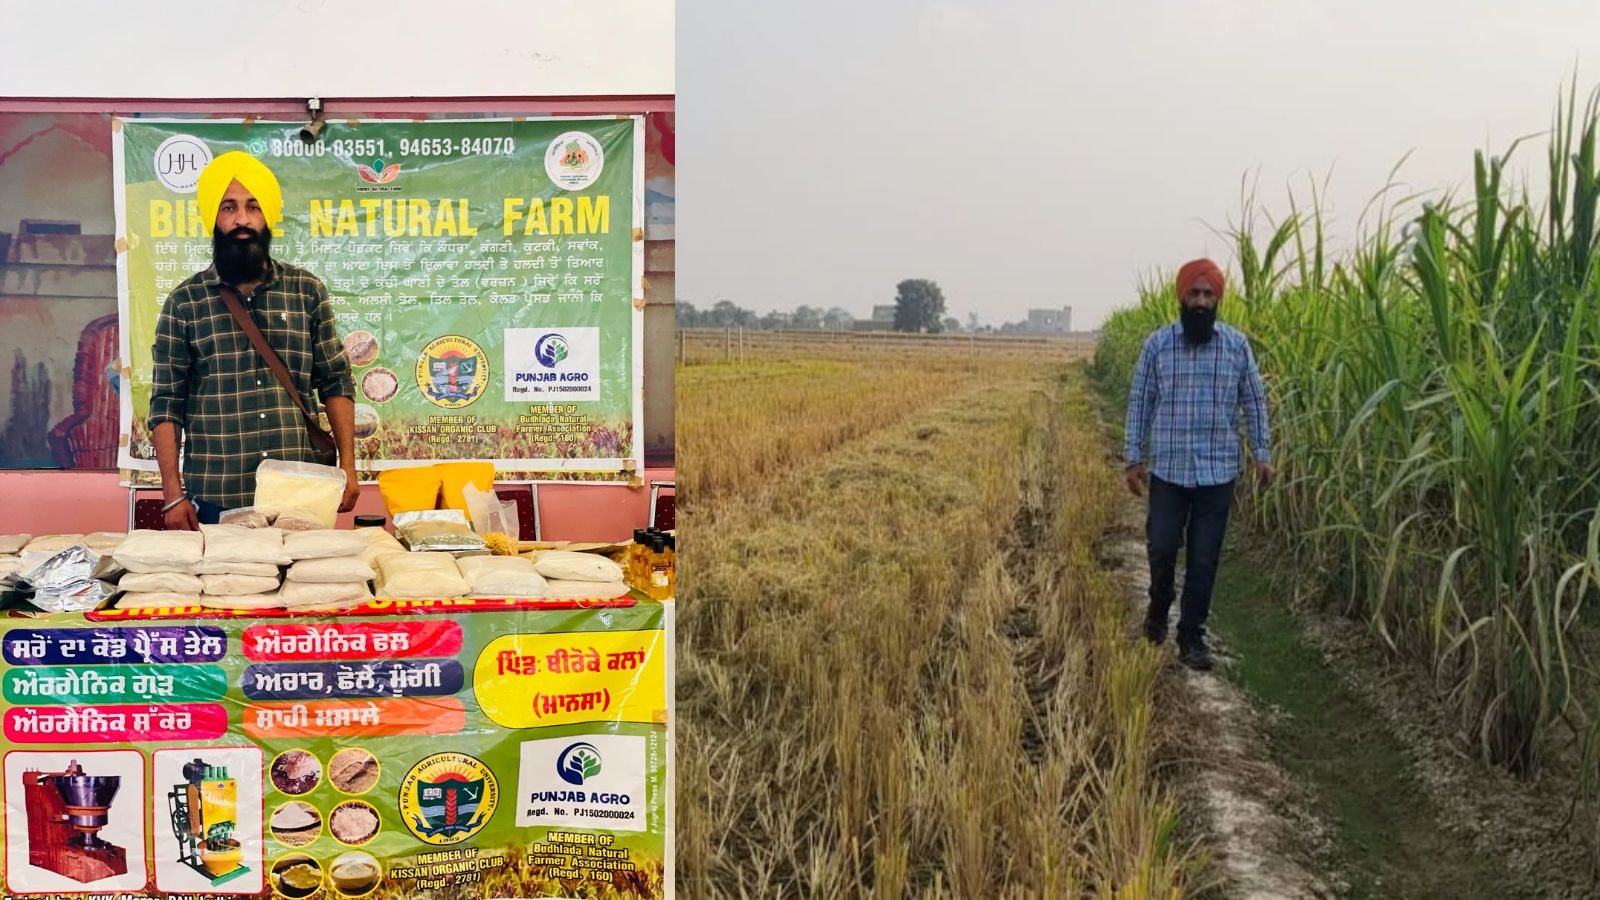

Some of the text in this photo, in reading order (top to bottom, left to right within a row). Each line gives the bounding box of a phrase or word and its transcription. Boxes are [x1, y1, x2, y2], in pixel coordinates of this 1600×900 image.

[400, 137, 514, 156] 94653-84070
[150, 195, 610, 238] BIR NATURAL FARM
[419, 241, 432, 253] ਕਿ
[420, 258, 458, 271] ਇਲਾਵਾ
[464, 257, 495, 270] ਹਲਦੀ
[513, 256, 545, 270] ਹਲਦੀ
[567, 256, 603, 268] ਤਿਆਰ
[451, 275, 470, 288] ਤੇਲ
[564, 273, 577, 286] ਕਿ
[590, 290, 603, 303] ਕਿ
[515, 373, 589, 382] PUNJAB AGRO
[530, 405, 577, 414] MEMBER OF
[429, 415, 477, 424] MEMBER OF
[559, 415, 587, 423] Natural
[409, 425, 437, 433] KISSAN
[440, 425, 474, 433] ORGANIC
[12, 633, 52, 659] ਸਰੋਂ
[59, 640, 86, 657] ਦਾ
[184, 630, 222, 656] ਤੇਲ
[373, 632, 409, 652] ਫਲ
[546, 647, 601, 673] ਬੀਰੋਕੇ
[606, 646, 645, 671] ਕਲਾਂ
[132, 675, 174, 699] ਗੁੜ
[255, 672, 332, 694] ਅਚਾਰ,
[532, 688, 610, 719] (ਮਾਨਸਾ)
[256, 701, 381, 730] ਸ਼ਾਹੀ ਮਸਾਲੇ
[403, 755, 495, 810] PUNJAB AGRICULTURAL UNIVERSITY
[530, 791, 630, 805] PUNJAB AGRO
[527, 808, 635, 819] Regd. No. PJ1502000024
[547, 831, 614, 846] MEMBER OF
[417, 848, 478, 865] MEMBER OF
[533, 843, 628, 859] Budhlada Natural
[391, 857, 505, 879] KISSAN ORGANIC CLUB
[528, 855, 635, 871] Farmer Association
[416, 872, 481, 890] (Regd. 2781)
[549, 867, 613, 883] (Regd. 160)
